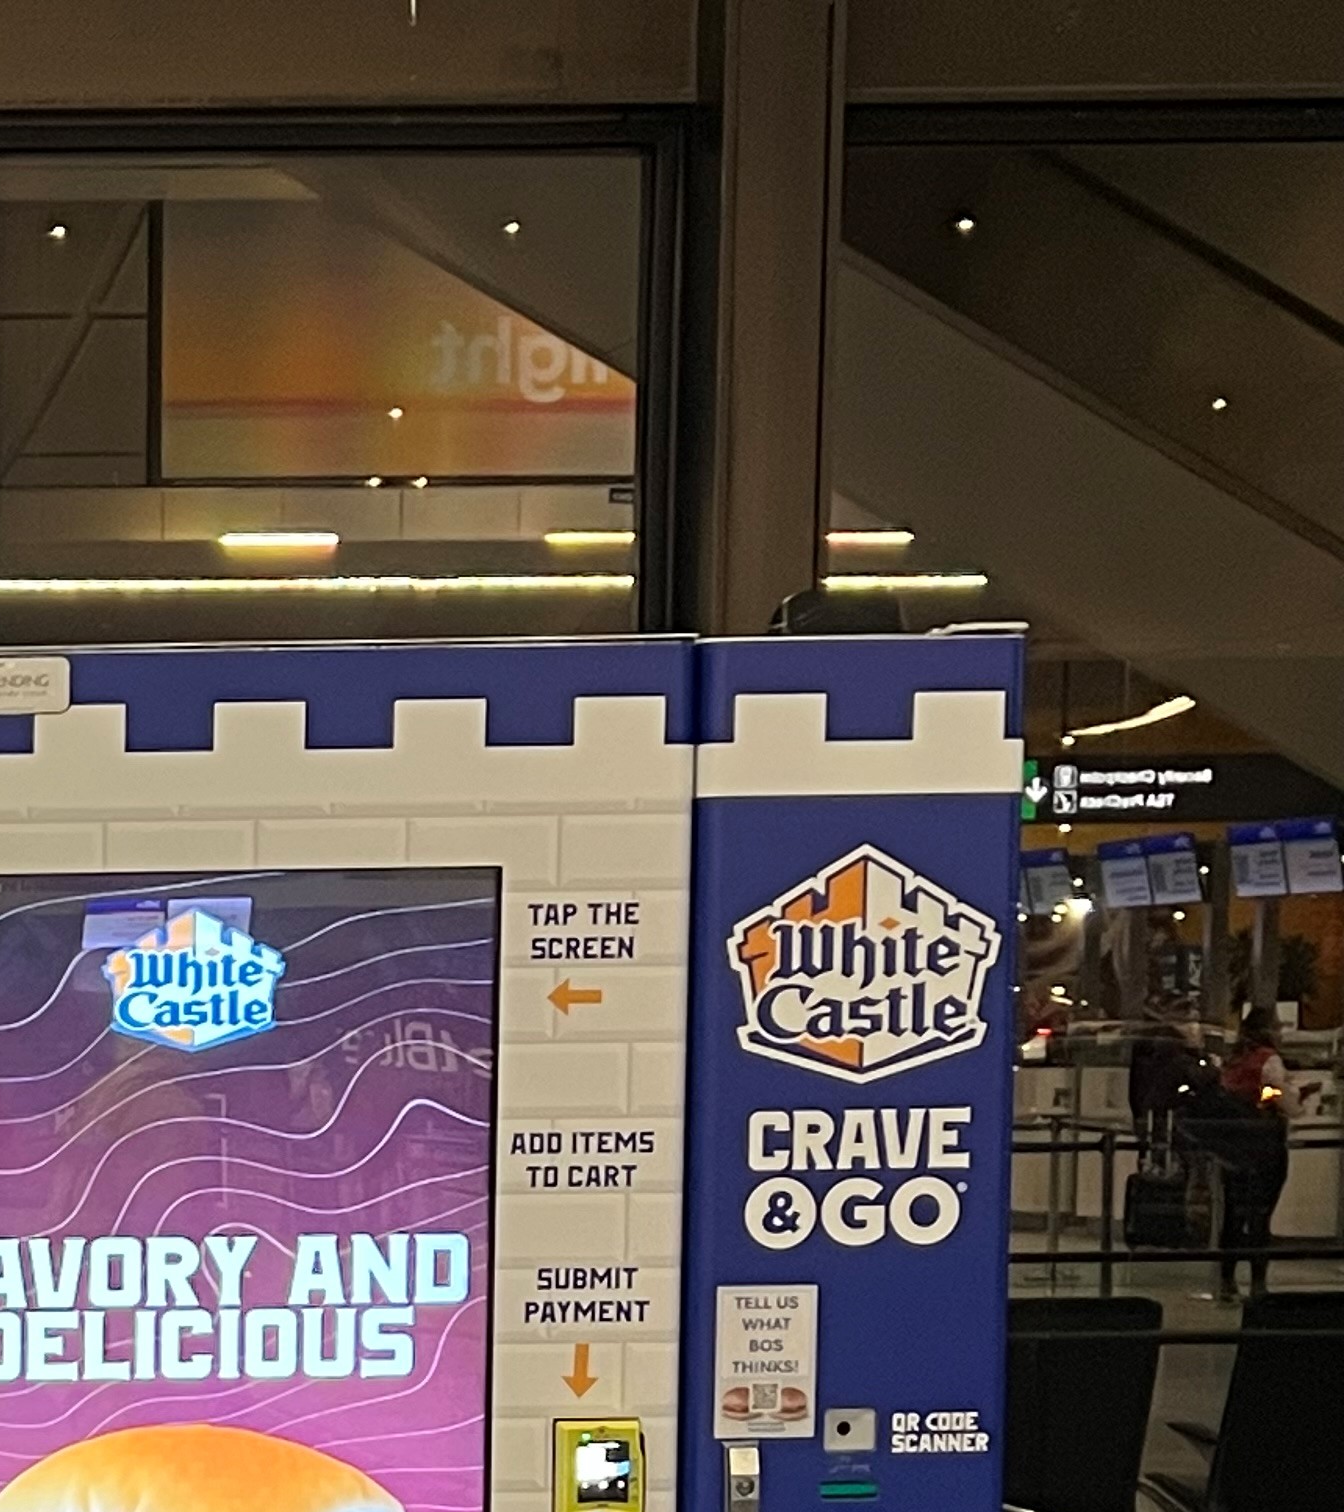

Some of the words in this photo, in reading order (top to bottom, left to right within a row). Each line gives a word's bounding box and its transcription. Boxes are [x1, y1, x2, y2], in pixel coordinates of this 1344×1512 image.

[528, 903, 578, 926] TAP
[589, 902, 640, 925] THE
[531, 937, 634, 960] SCREEN
[773, 920, 962, 989] White
[132, 951, 264, 991] White
[115, 991, 273, 1027] Castle
[756, 983, 968, 1039] Castle
[511, 1132, 562, 1155] ADD
[571, 1131, 655, 1154] ITEMS
[749, 1107, 971, 1171] CRAVE
[526, 1166, 558, 1188] TO
[568, 1165, 637, 1188] CART
[290, 1232, 470, 1305] AND
[537, 1268, 638, 1291] SUBMIT
[524, 1301, 650, 1324] PAYMENT
[735, 1296, 771, 1310] TELL
[777, 1296, 799, 1309] US
[742, 1318, 792, 1331] WHAT
[749, 1339, 783, 1352] BOS
[732, 1360, 799, 1373] THINKS!
[892, 1413, 920, 1433] QR
[925, 1411, 979, 1431] CODE
[891, 1433, 989, 1454] SCANNER
